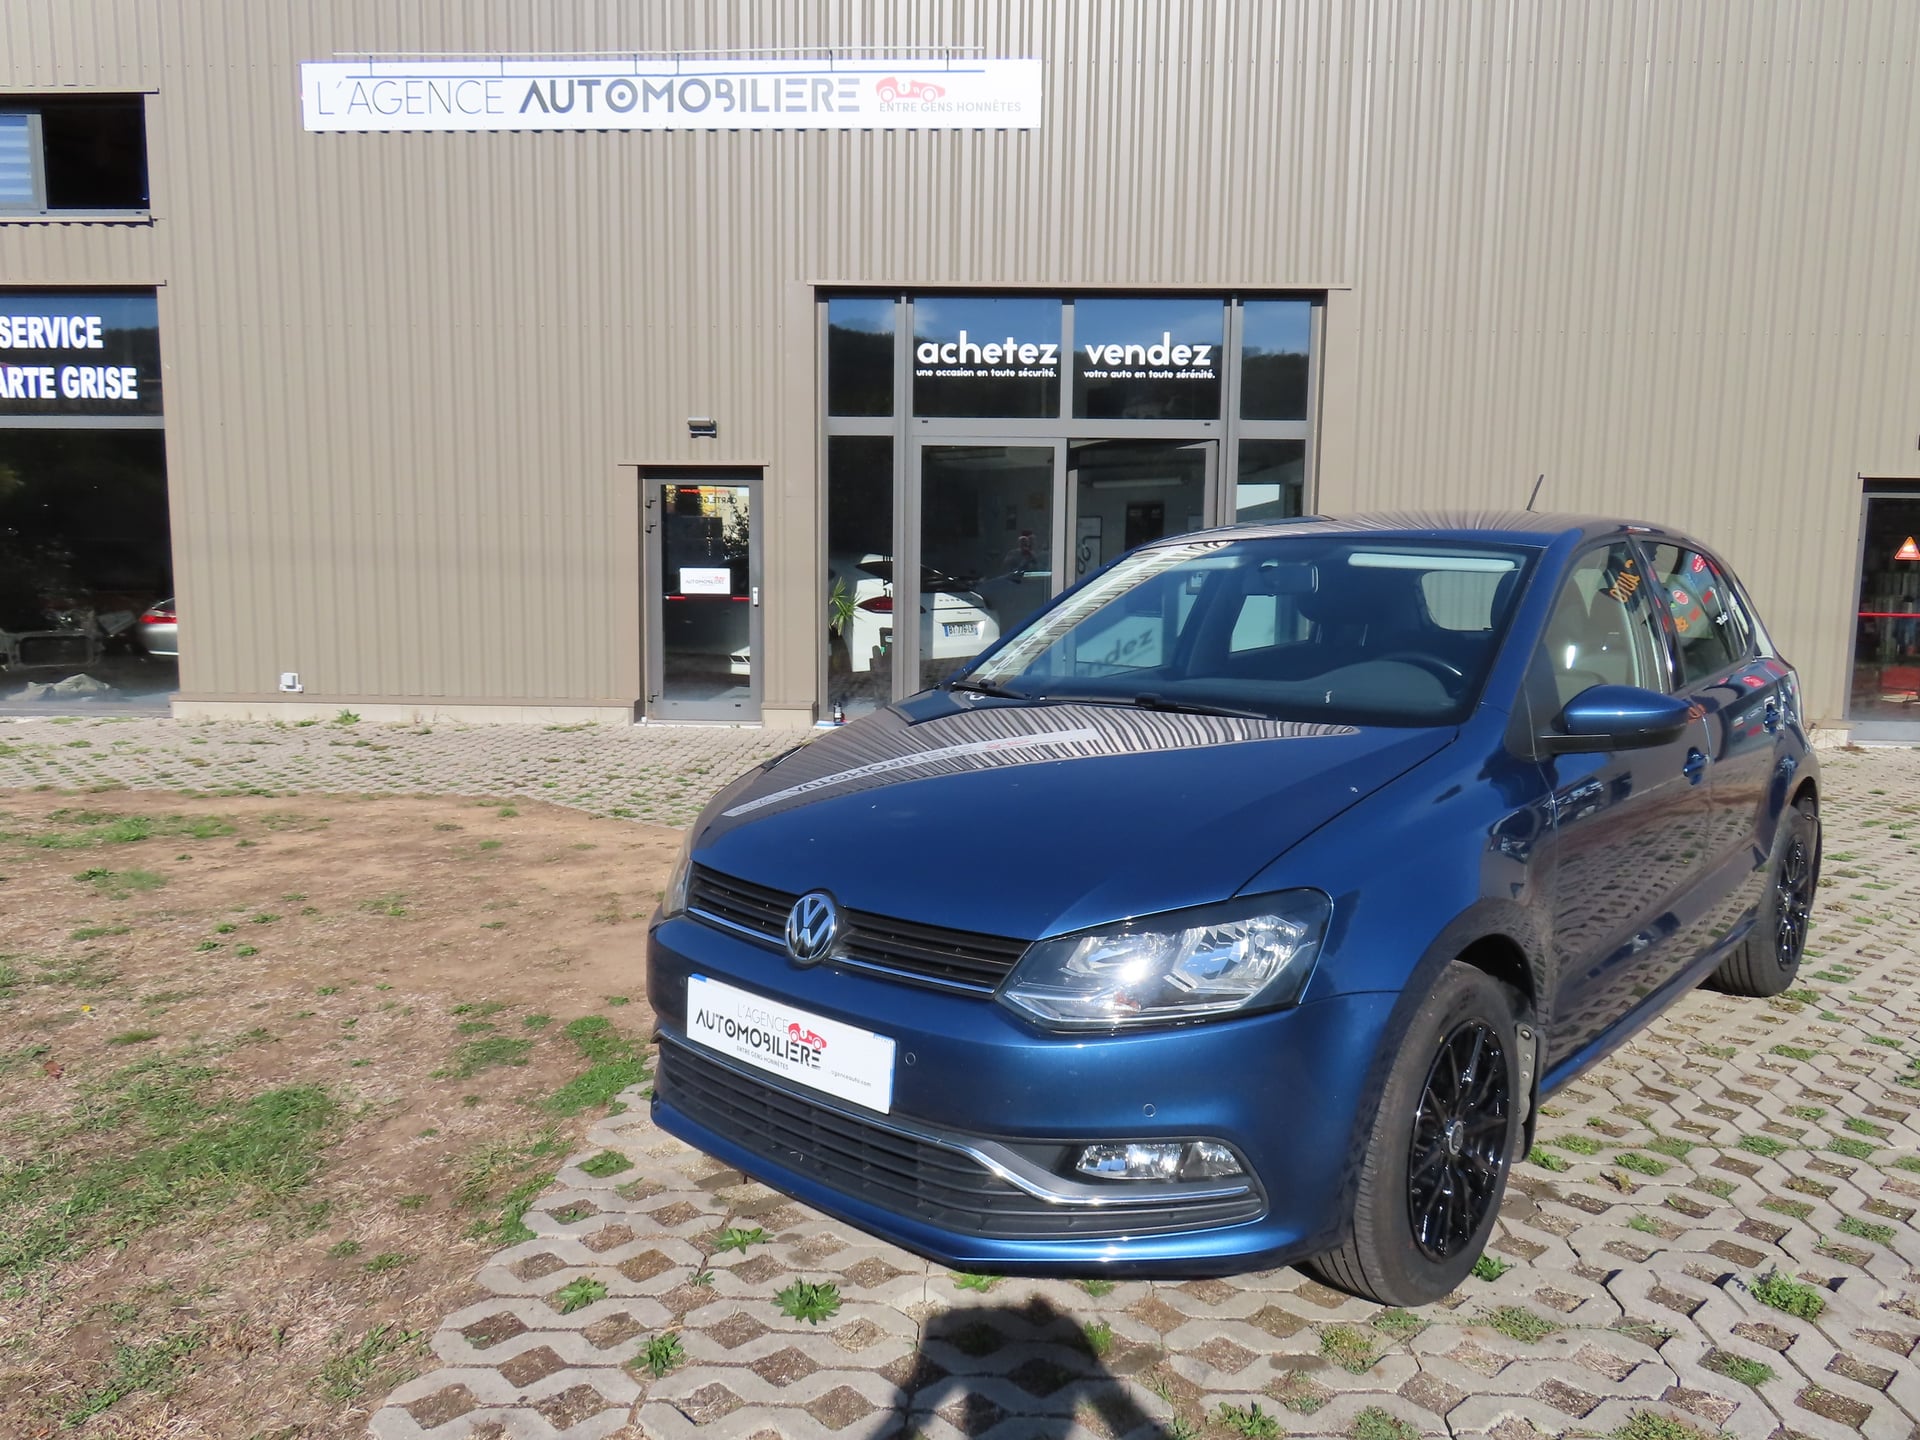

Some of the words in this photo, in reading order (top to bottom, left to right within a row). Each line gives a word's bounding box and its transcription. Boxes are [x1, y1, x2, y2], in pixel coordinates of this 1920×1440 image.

[317, 80, 504, 115] L'AGENCE
[519, 78, 860, 114] AUTOMOBILIERE
[879, 102, 917, 112] ENTRE
[920, 102, 953, 112] GENS
[956, 99, 1022, 113] HONNÊTES
[0, 316, 104, 349] SERVICE
[916, 330, 1059, 365] achetez
[1085, 331, 1212, 366] vendez
[61, 366, 138, 399] GRISE
[915, 369, 934, 377] une
[936, 367, 975, 377] occasion
[976, 369, 989, 377] en
[990, 368, 1016, 377] toute
[1018, 367, 1057, 378] sécurité.
[1083, 370, 1109, 378] votre
[1110, 369, 1132, 379] auto
[1134, 370, 1147, 379] en
[1148, 369, 1174, 379] toute
[1175, 368, 1217, 379] sérénité.
[737, 1003, 789, 1034] L'AGENCE
[695, 1008, 822, 1069] AUTOMOBILIERE
[736, 1045, 750, 1056] ENTRE
